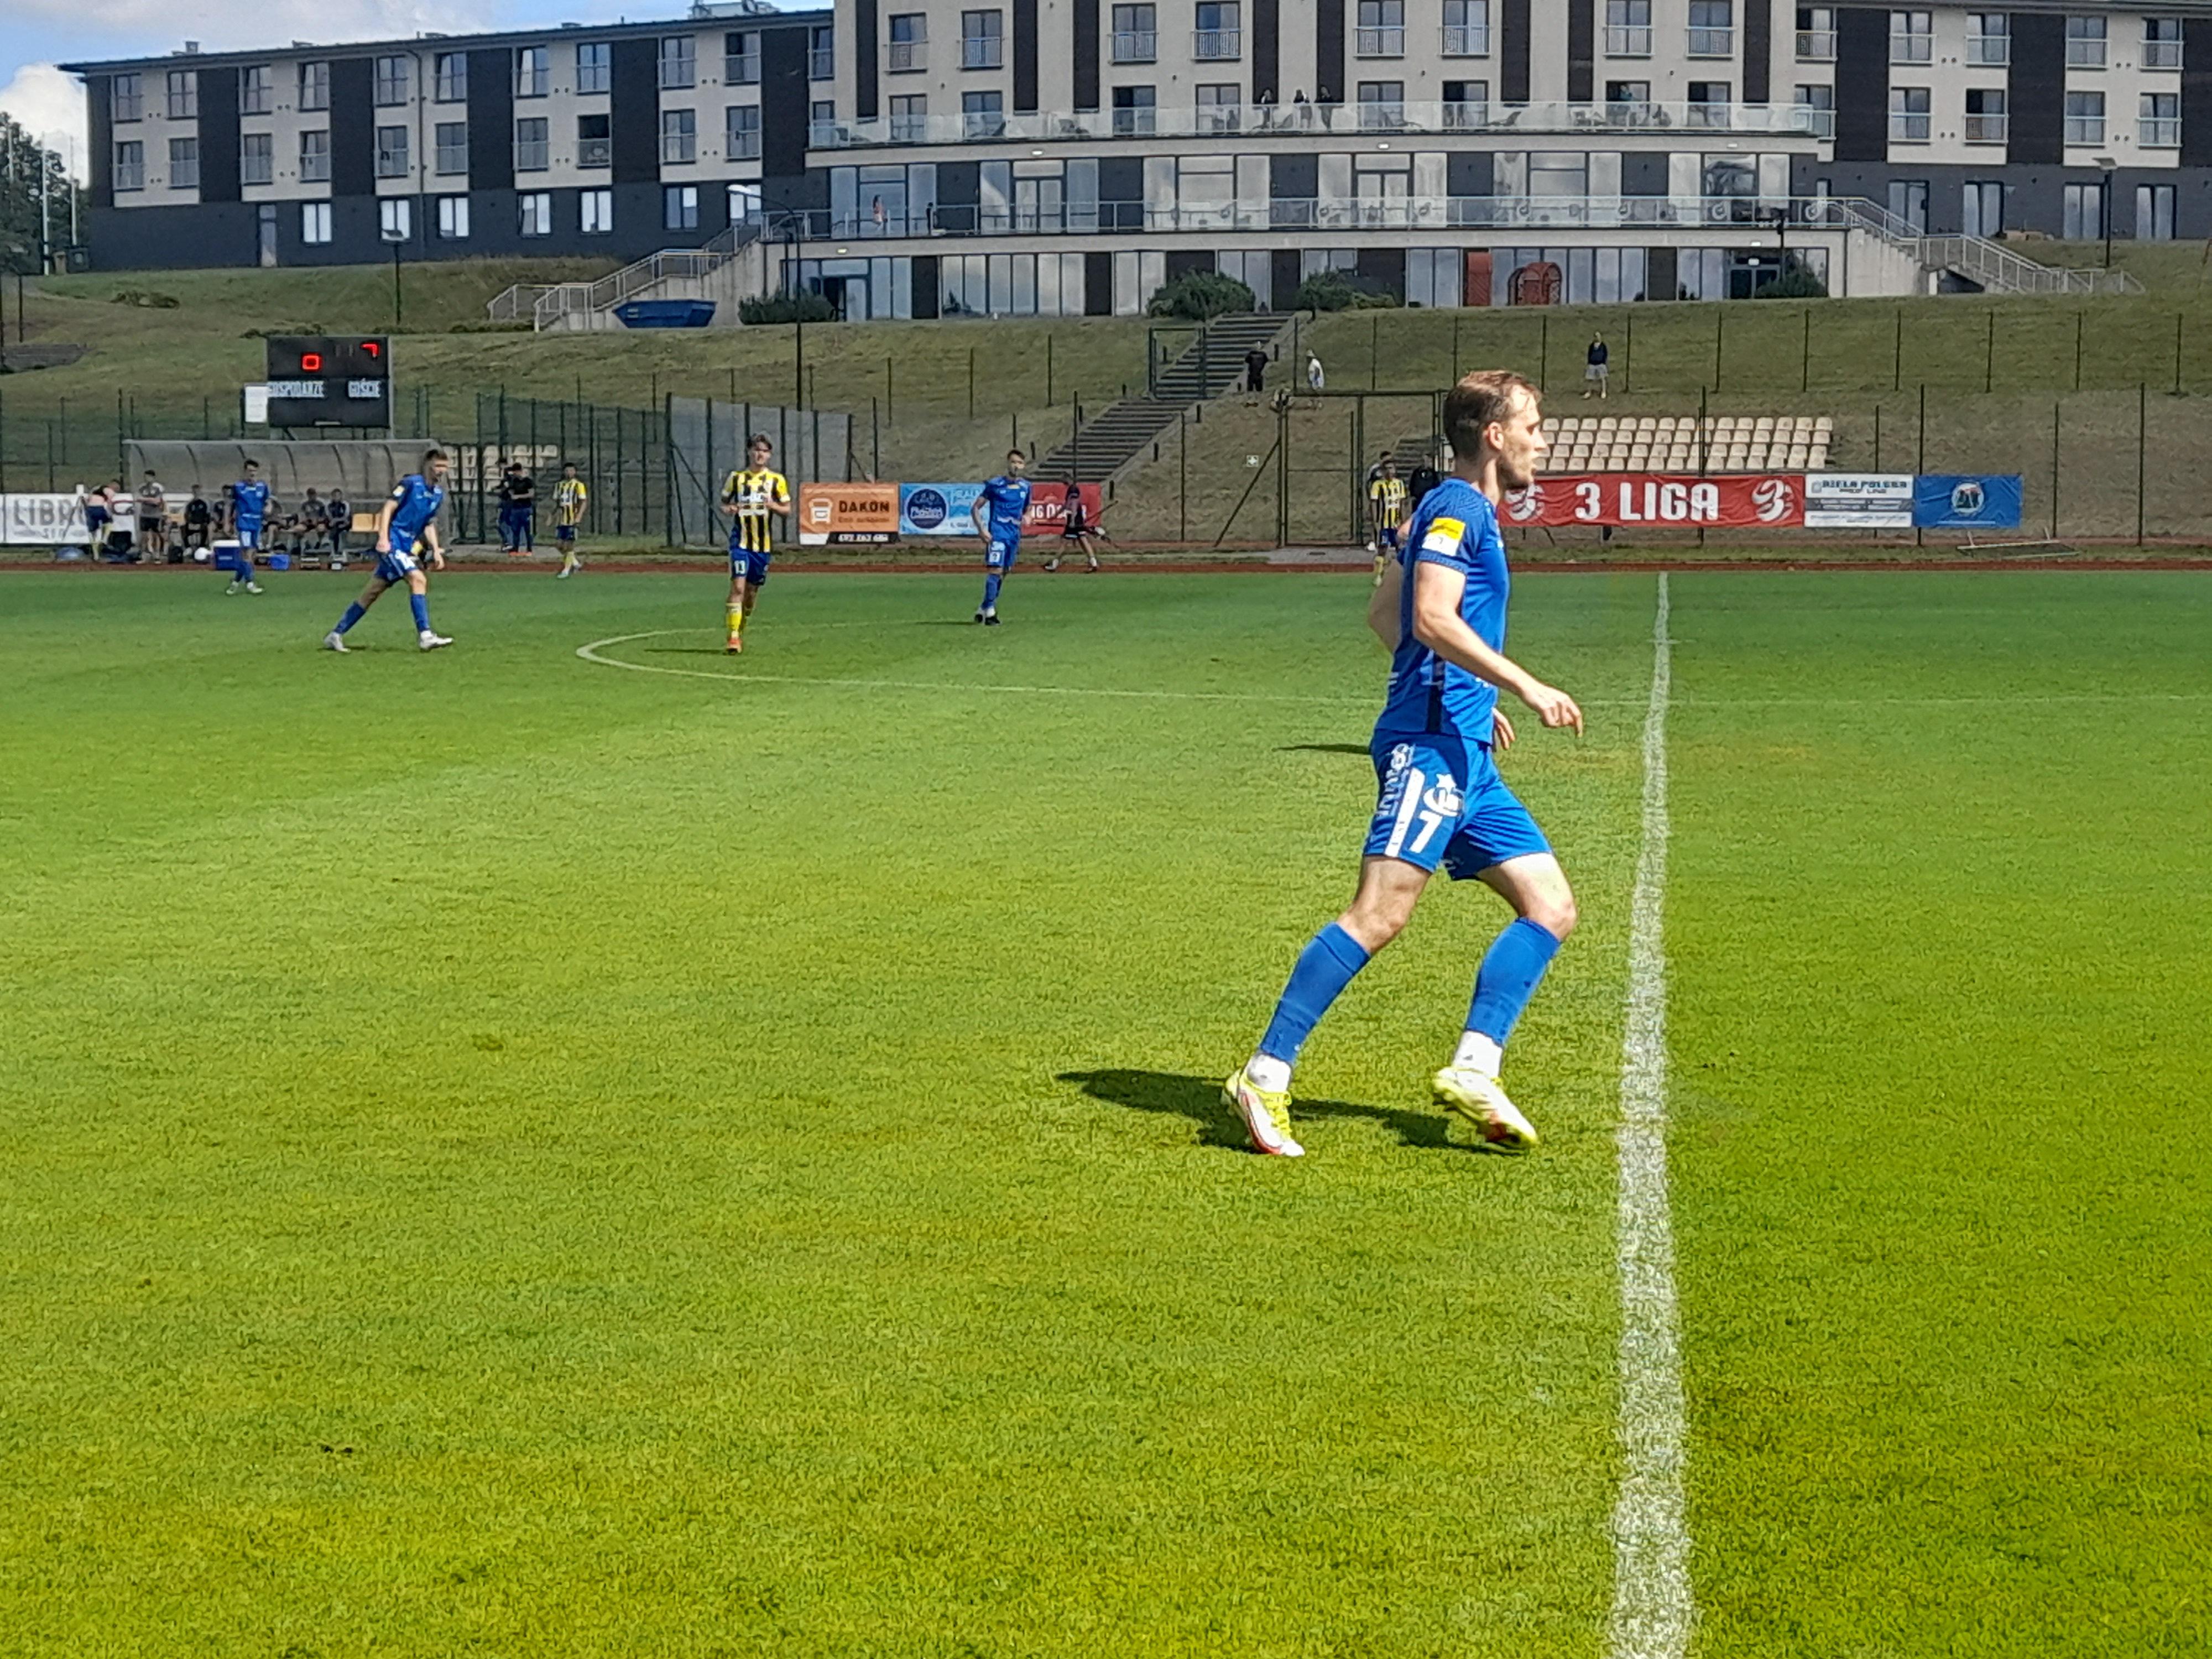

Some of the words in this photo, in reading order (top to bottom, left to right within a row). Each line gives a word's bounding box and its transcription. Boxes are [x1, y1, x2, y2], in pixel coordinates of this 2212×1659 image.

[838, 500, 890, 513] DAKON
[1574, 482, 1601, 520] 3
[1619, 482, 1719, 520] LIGA
